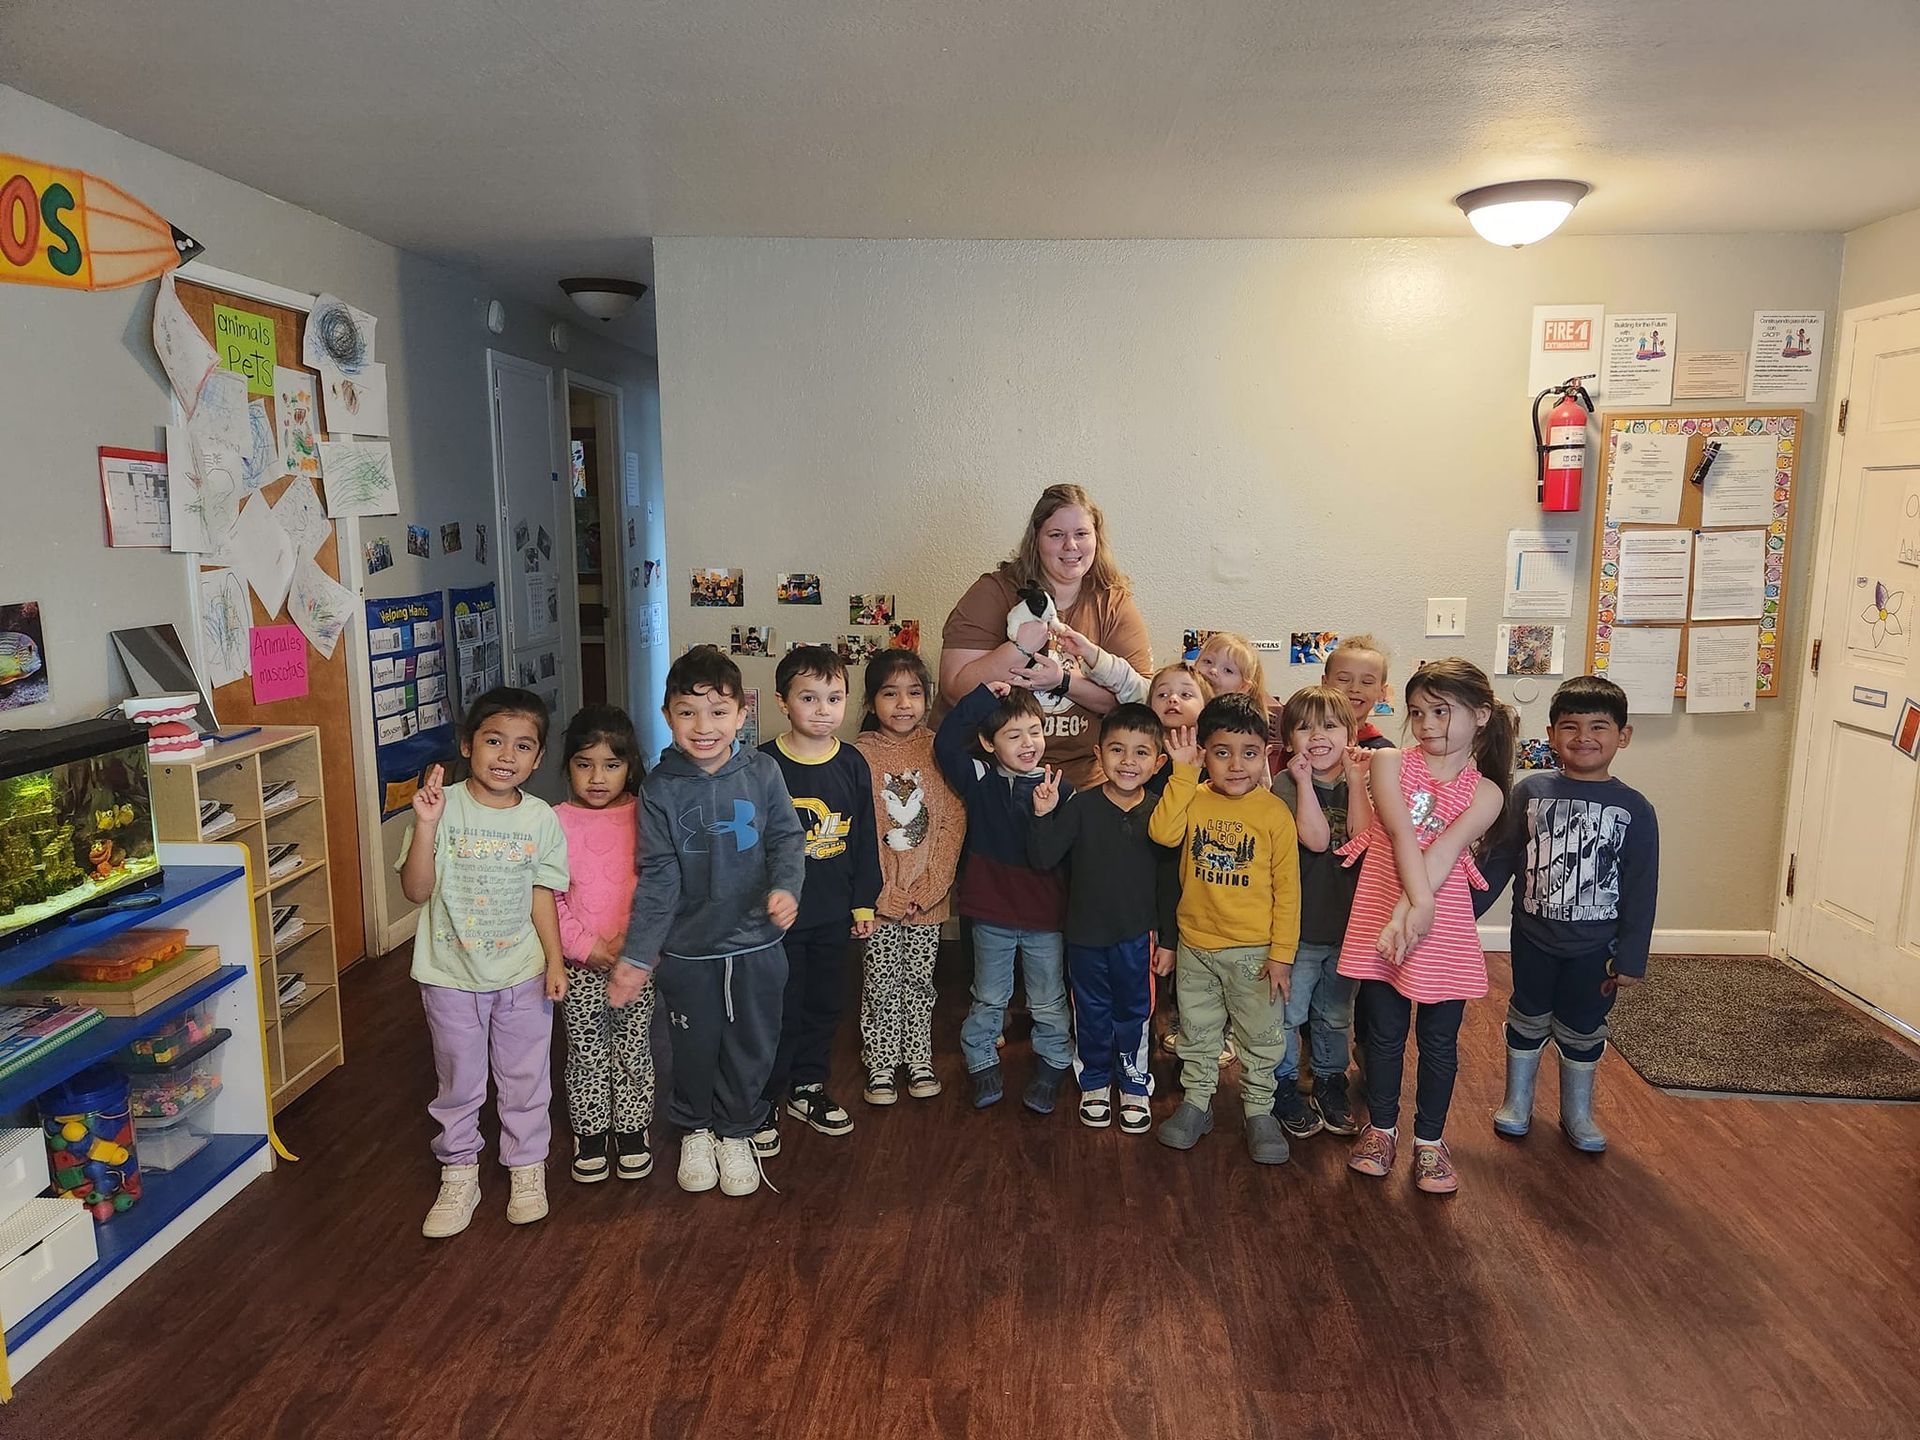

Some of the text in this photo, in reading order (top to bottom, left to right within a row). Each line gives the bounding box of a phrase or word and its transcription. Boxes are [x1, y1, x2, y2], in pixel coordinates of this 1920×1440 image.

[217, 313, 270, 346] animals
[1546, 321, 1575, 341] FIRE
[1614, 321, 1635, 329] Building
[228, 345, 273, 387] Pets
[379, 604, 428, 624] Helping Hands
[253, 630, 301, 656] Animales
[260, 661, 306, 685] mascotas
[480, 829, 510, 840] Things
[512, 831, 533, 841] With
[1207, 818, 1244, 834] LET'S
[1216, 830, 1237, 846] GO
[1525, 798, 1633, 906] KING
[1194, 866, 1250, 887] FISHING
[1523, 897, 1540, 915] OF
[1540, 901, 1571, 922] THE
